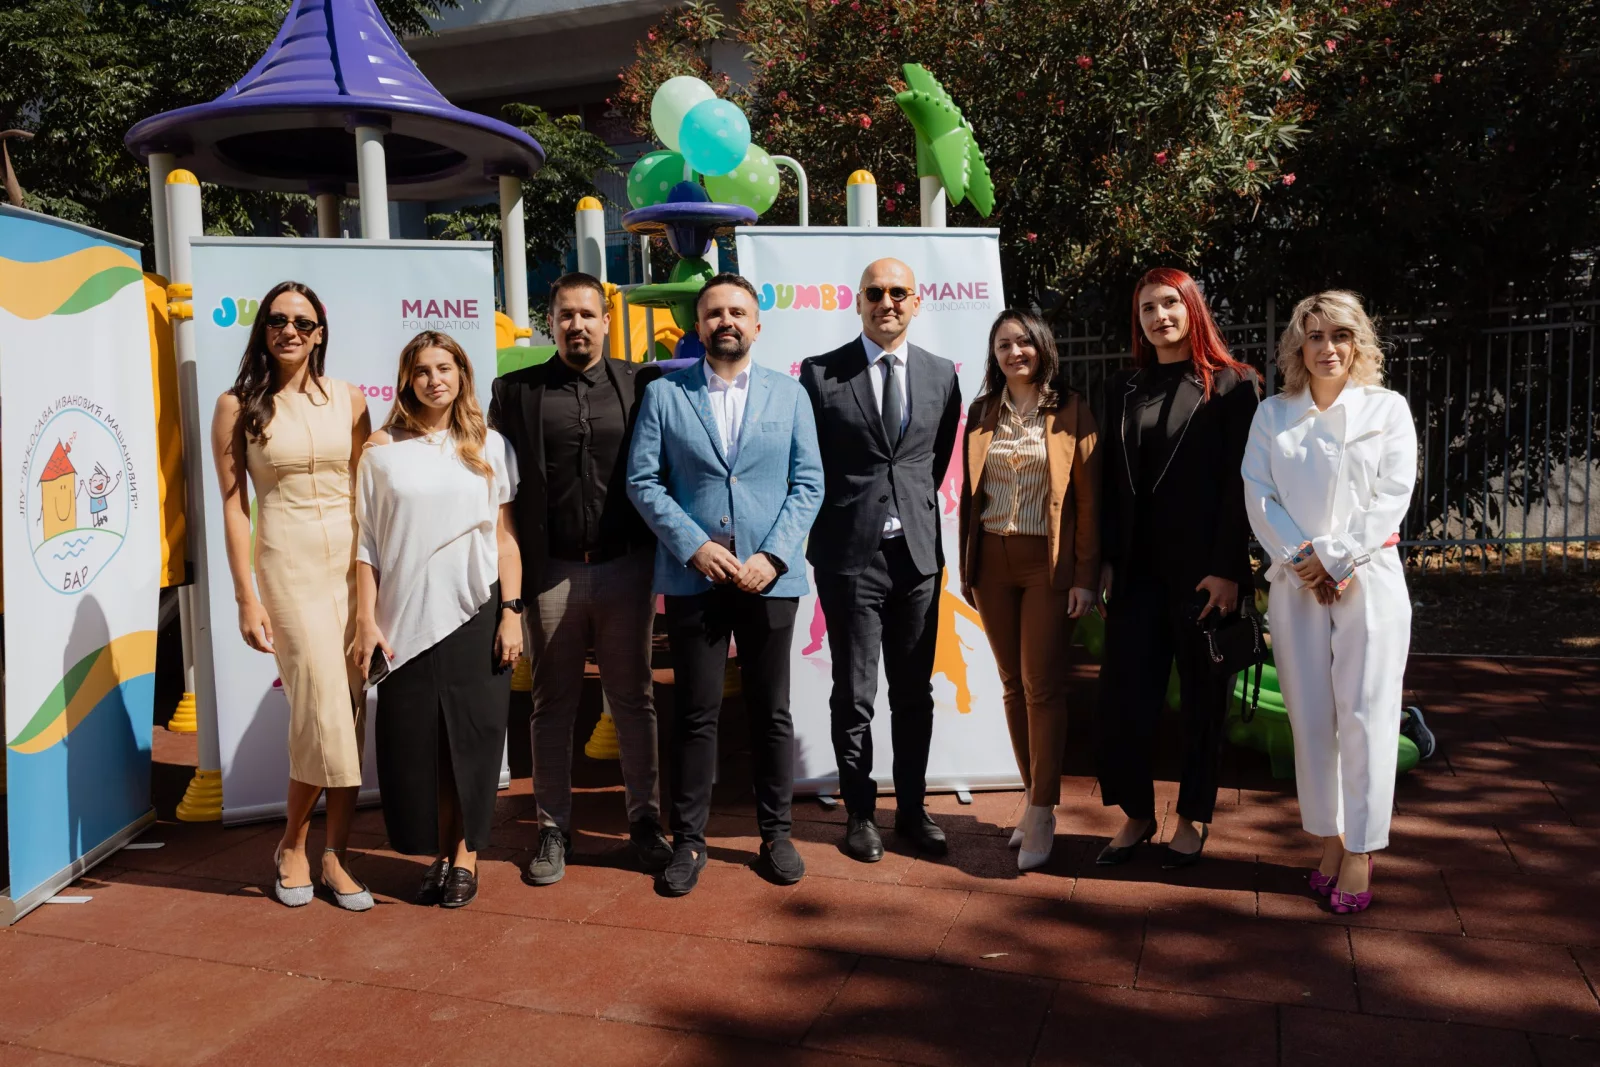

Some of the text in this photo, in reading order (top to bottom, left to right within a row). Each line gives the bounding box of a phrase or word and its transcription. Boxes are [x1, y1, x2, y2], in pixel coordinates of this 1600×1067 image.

[757, 282, 853, 311] JUMBO
[919, 282, 989, 301] MANE
[401, 299, 479, 319] MANE
[920, 301, 991, 311] FOUNDATION
[402, 320, 480, 330] FOUNDATION
[63, 565, 89, 590] БАР
